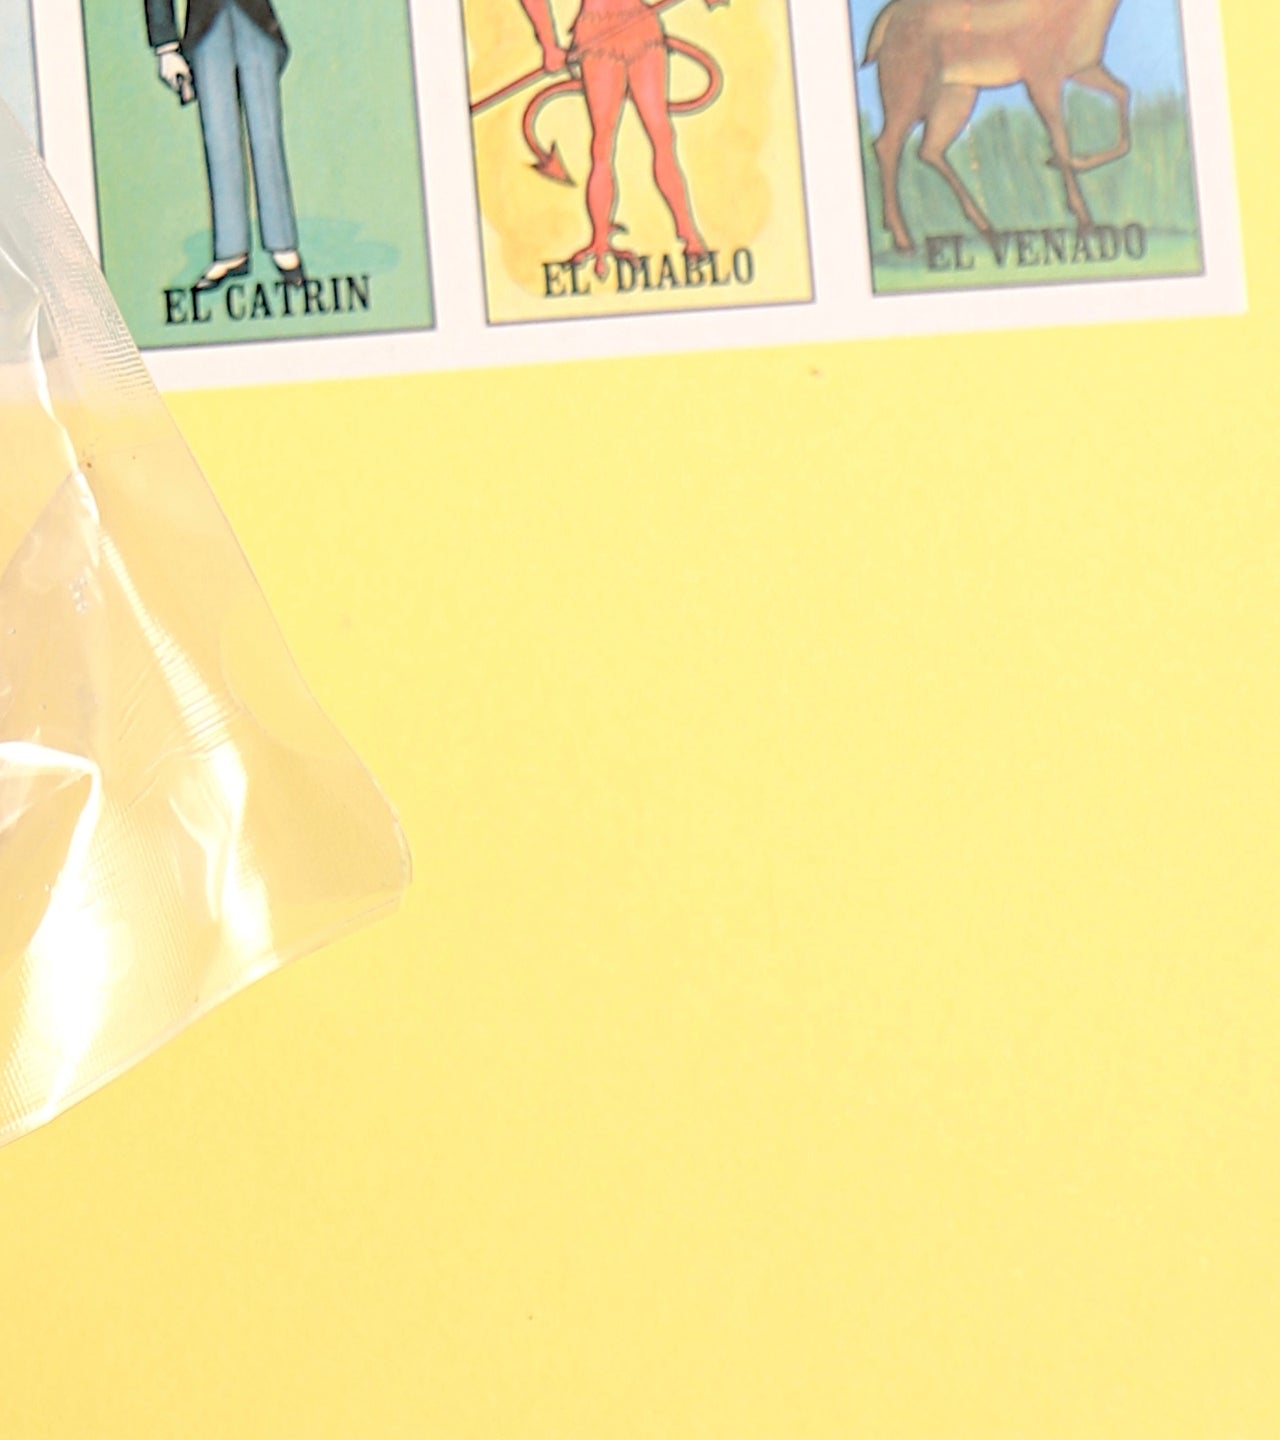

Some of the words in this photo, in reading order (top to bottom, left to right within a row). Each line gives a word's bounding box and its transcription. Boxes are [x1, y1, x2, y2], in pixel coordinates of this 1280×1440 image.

[925, 236, 974, 273] EL
[990, 222, 1147, 265] VENADO
[164, 288, 213, 327] EL
[226, 275, 371, 320] CATRIN
